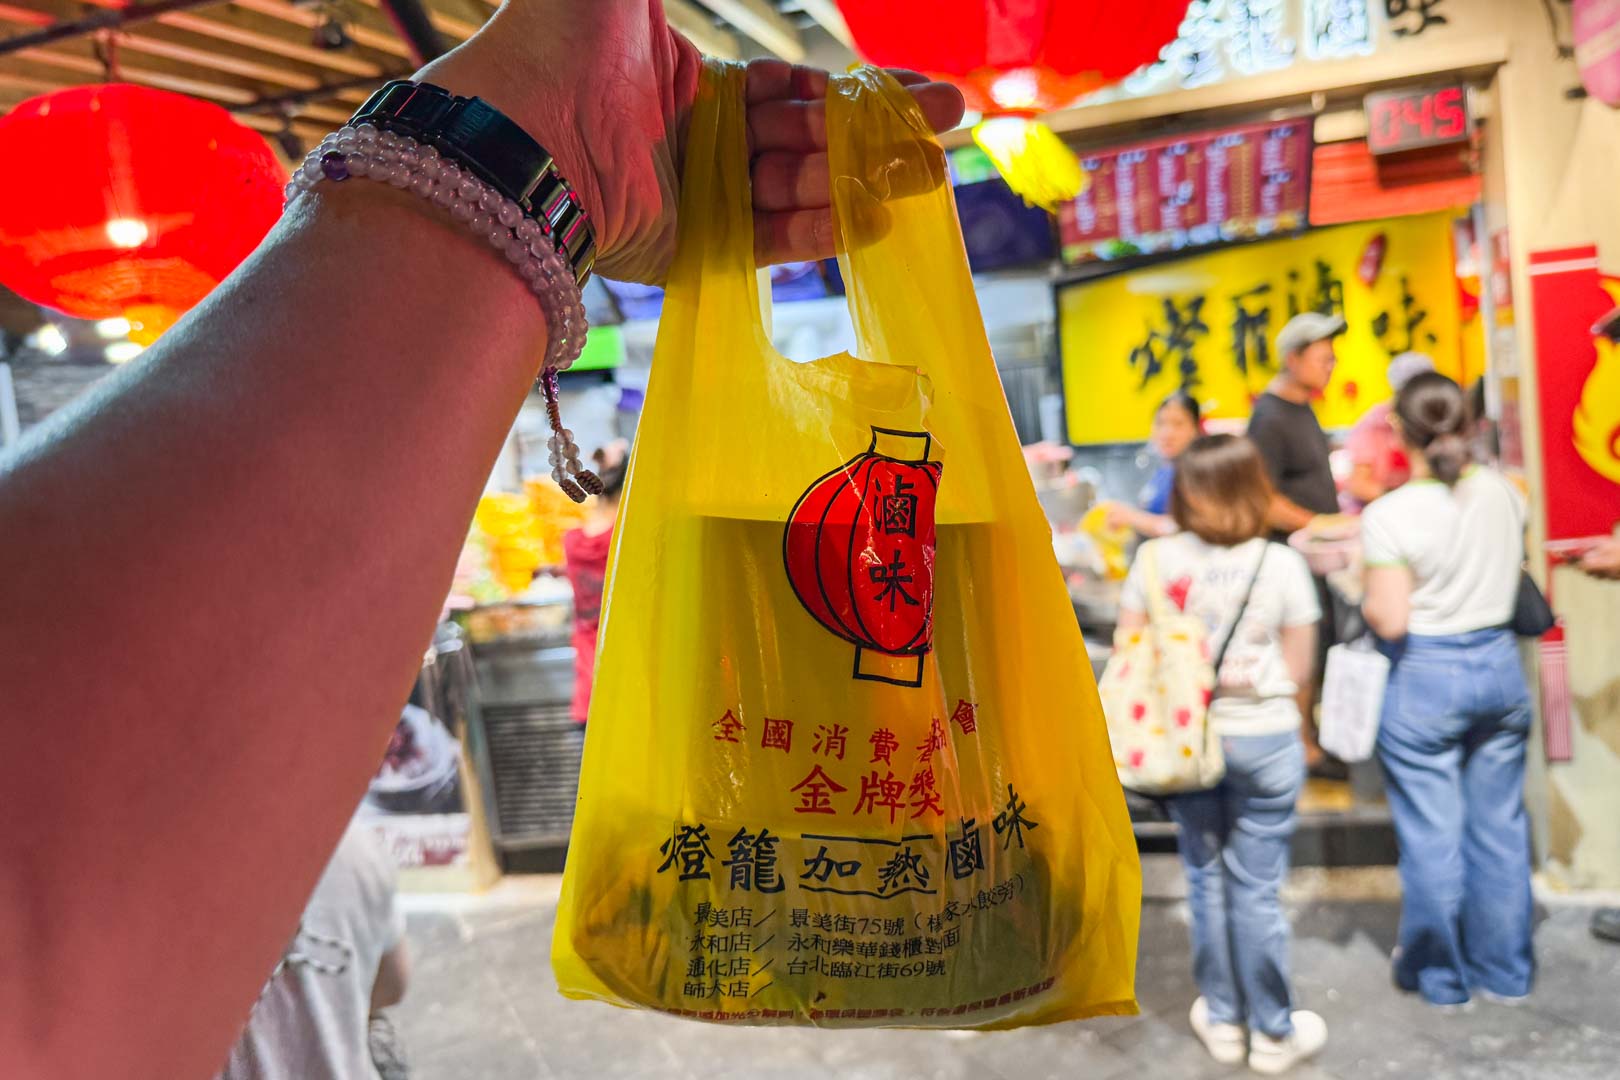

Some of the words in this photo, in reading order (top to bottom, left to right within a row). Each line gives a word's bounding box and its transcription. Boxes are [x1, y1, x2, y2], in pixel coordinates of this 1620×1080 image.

[869, 474, 920, 613] 滷味
[790, 763, 945, 824] 金牌獎
[786, 954, 946, 980] 台北臨江街69號
